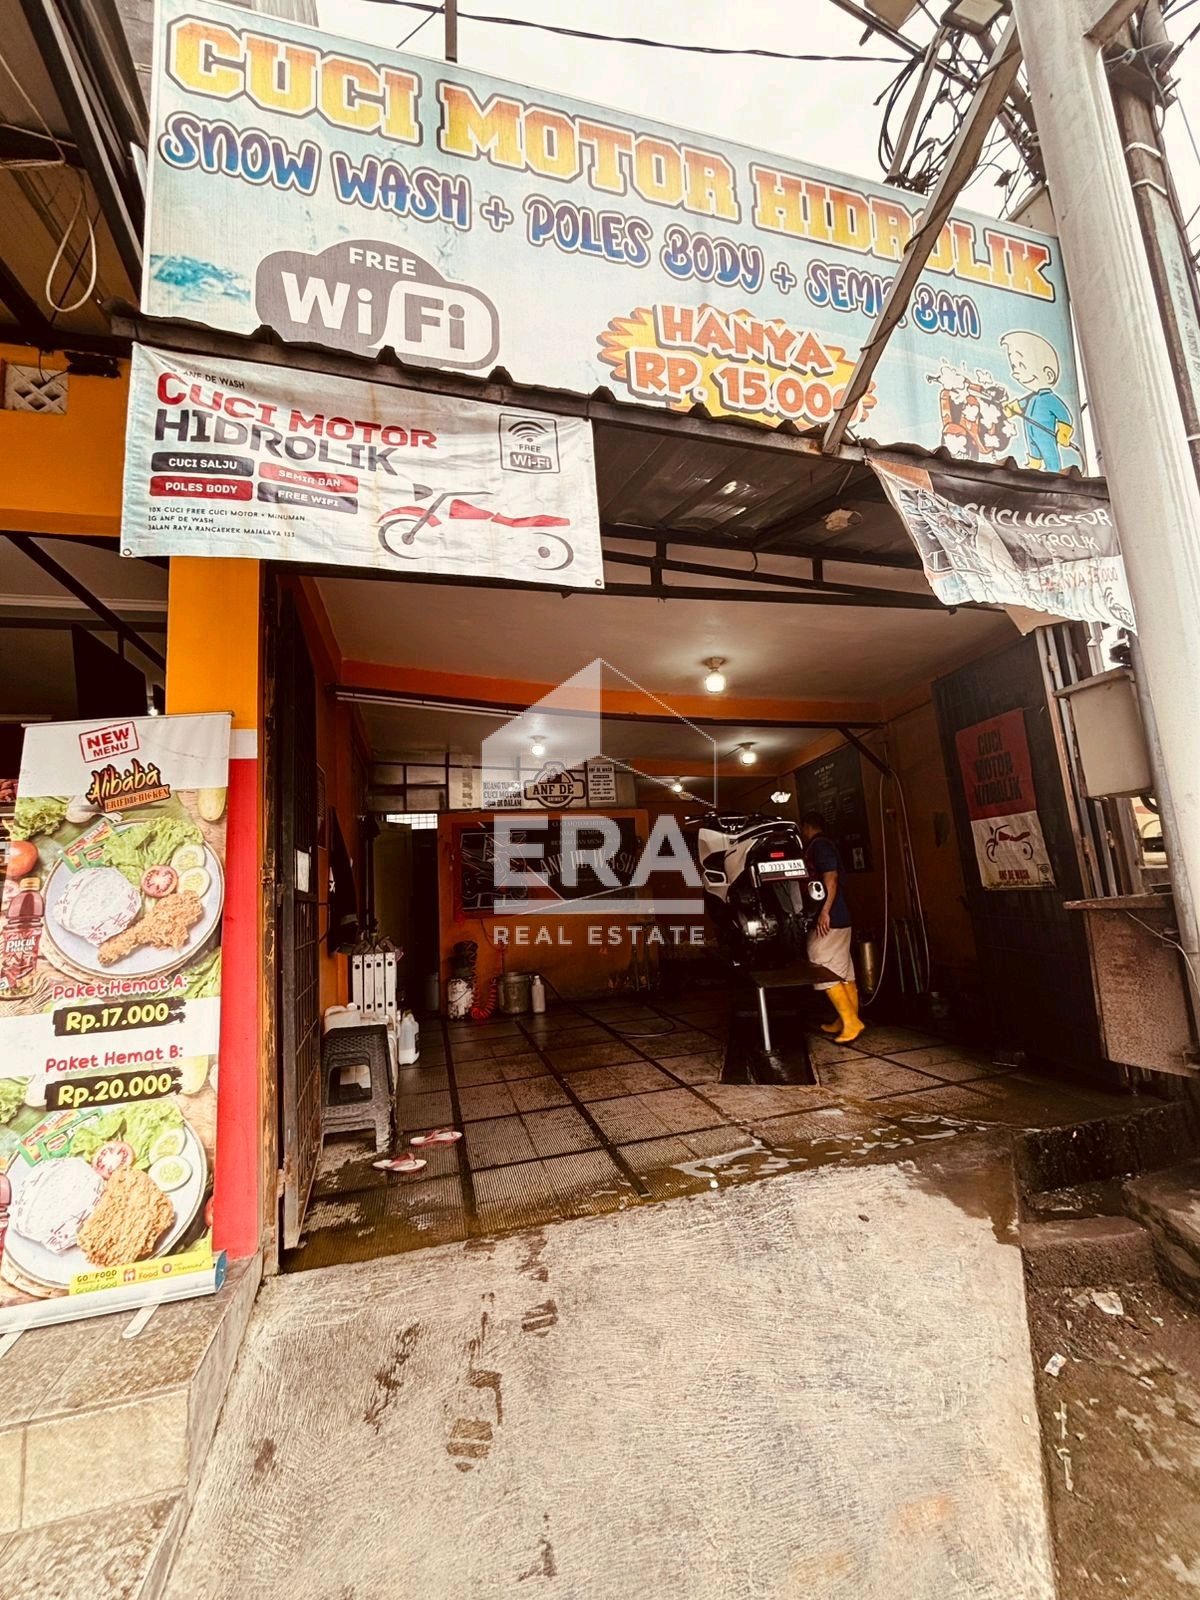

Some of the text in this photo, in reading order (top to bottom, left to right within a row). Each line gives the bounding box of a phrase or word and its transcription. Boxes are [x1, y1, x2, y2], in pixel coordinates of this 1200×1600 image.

[168, 16, 420, 143] CUCI
[439, 81, 738, 221] MOTOR
[160, 113, 979, 336] SNOW WASH + POLES BODY + SEMI BAN
[349, 247, 417, 277] FREE
[660, 306, 834, 374] HANYA
[205, 374, 217, 384] DE
[219, 377, 245, 389] WASH
[157, 372, 438, 450] CUCI MOTOR
[155, 408, 398, 476] HIDROLIK
[519, 444, 541, 453] FREE
[168, 457, 238, 470] CUCI SALJU
[512, 455, 550, 468] Wi-Fi
[165, 482, 238, 494] POLES BODY
[278, 469, 341, 487] SEMIR BAN
[278, 490, 339, 507] FREE WIFI
[268, 513, 306, 521] MINUMAN
[195, 526, 241, 534] RANCAEKEK
[86, 727, 130, 749] NEW
[93, 741, 129, 757] MENU
[87, 759, 160, 808] Alibaba
[533, 784, 574, 795] ANF DE
[53, 975, 188, 999] Paket Hemat A:
[66, 1003, 169, 1033] Rp.17.000
[46, 1045, 184, 1073] Paket Hemat B:
[58, 1073, 172, 1107] Rp.20.000
